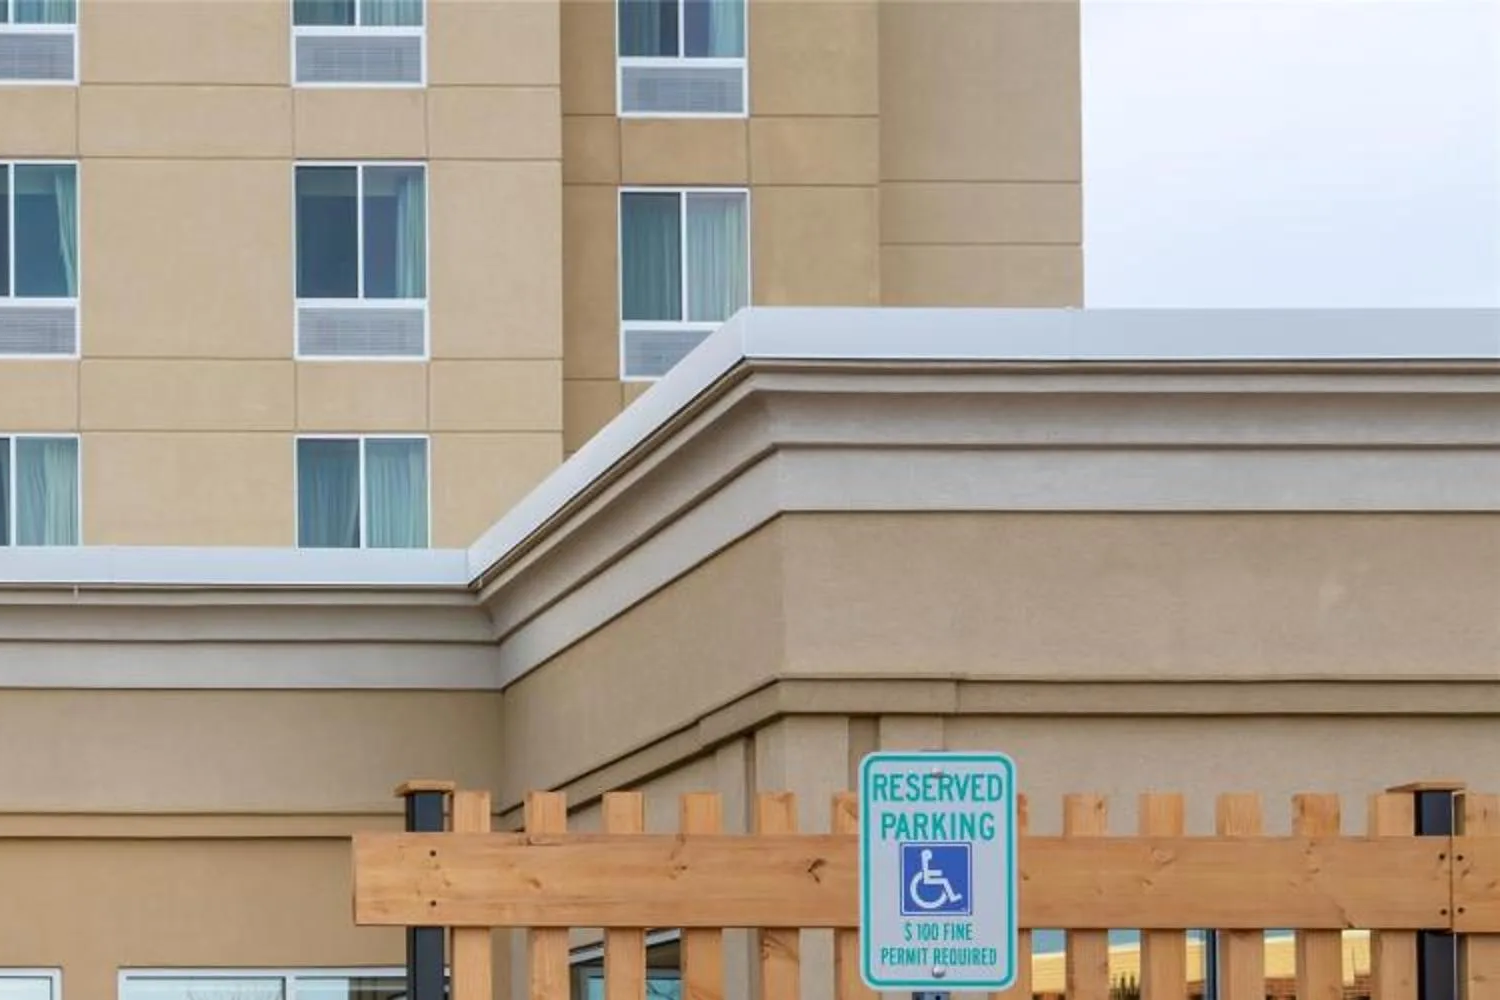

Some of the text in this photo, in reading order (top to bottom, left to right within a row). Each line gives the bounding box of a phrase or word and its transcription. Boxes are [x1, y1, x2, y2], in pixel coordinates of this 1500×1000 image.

[872, 773, 1004, 802] RESERVED
[881, 812, 996, 841] PARKING
[916, 923, 940, 942] 100
[943, 923, 973, 942] FINE
[881, 948, 998, 967] PERMIT REQUIRED
